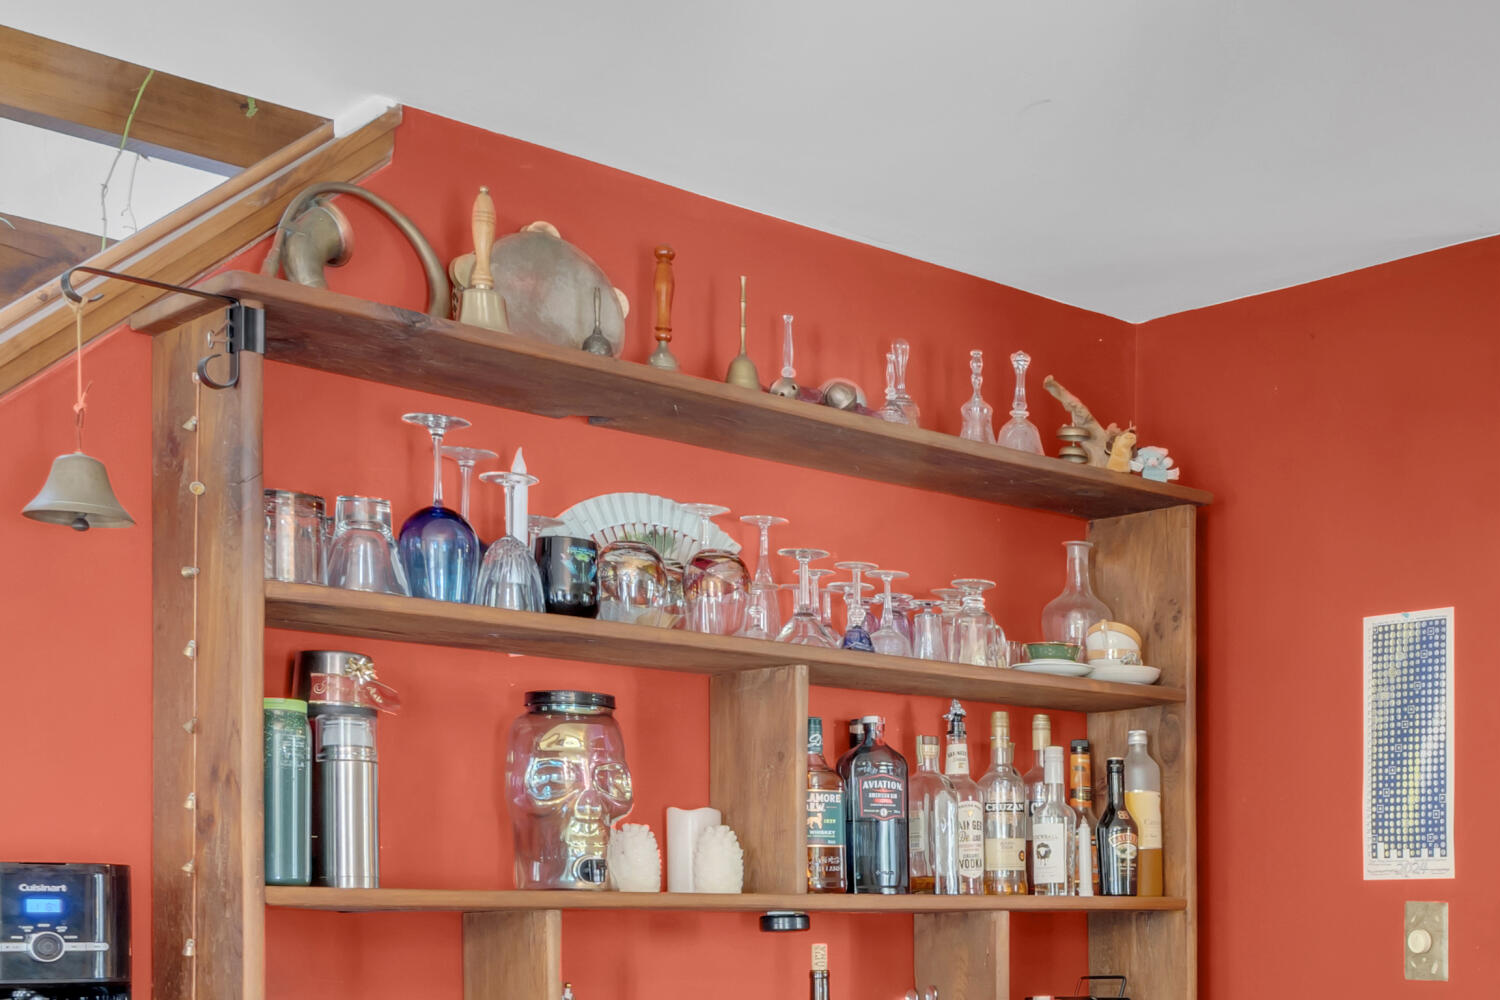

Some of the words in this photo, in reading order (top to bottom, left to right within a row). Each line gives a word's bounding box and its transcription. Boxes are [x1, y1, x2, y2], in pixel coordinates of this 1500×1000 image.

[863, 780, 903, 791] AVIATION
[985, 803, 1024, 812] CRUZAN
[18, 883, 67, 892] Cuisinart
